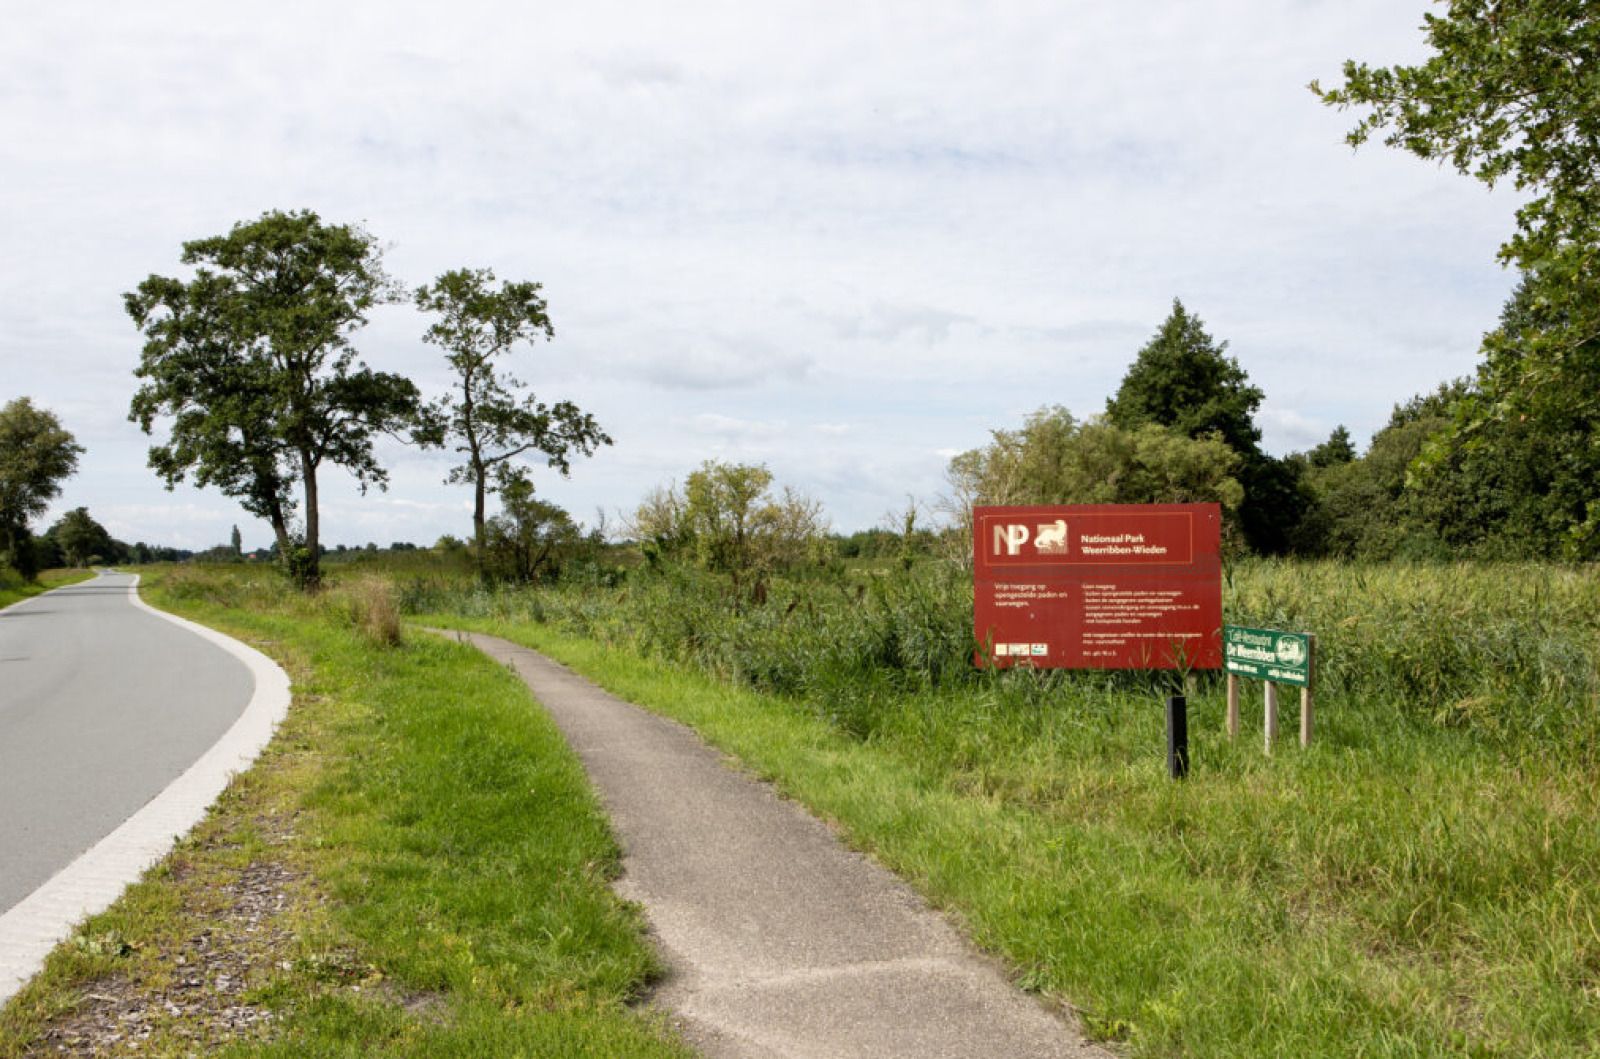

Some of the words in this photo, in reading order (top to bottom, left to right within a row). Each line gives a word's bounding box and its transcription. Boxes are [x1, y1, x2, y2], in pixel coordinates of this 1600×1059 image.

[993, 524, 1030, 556] NP
[1081, 534, 1123, 543] Nationaal
[1125, 534, 1144, 543] Park
[1081, 545, 1167, 554] Weerribben-Wieden
